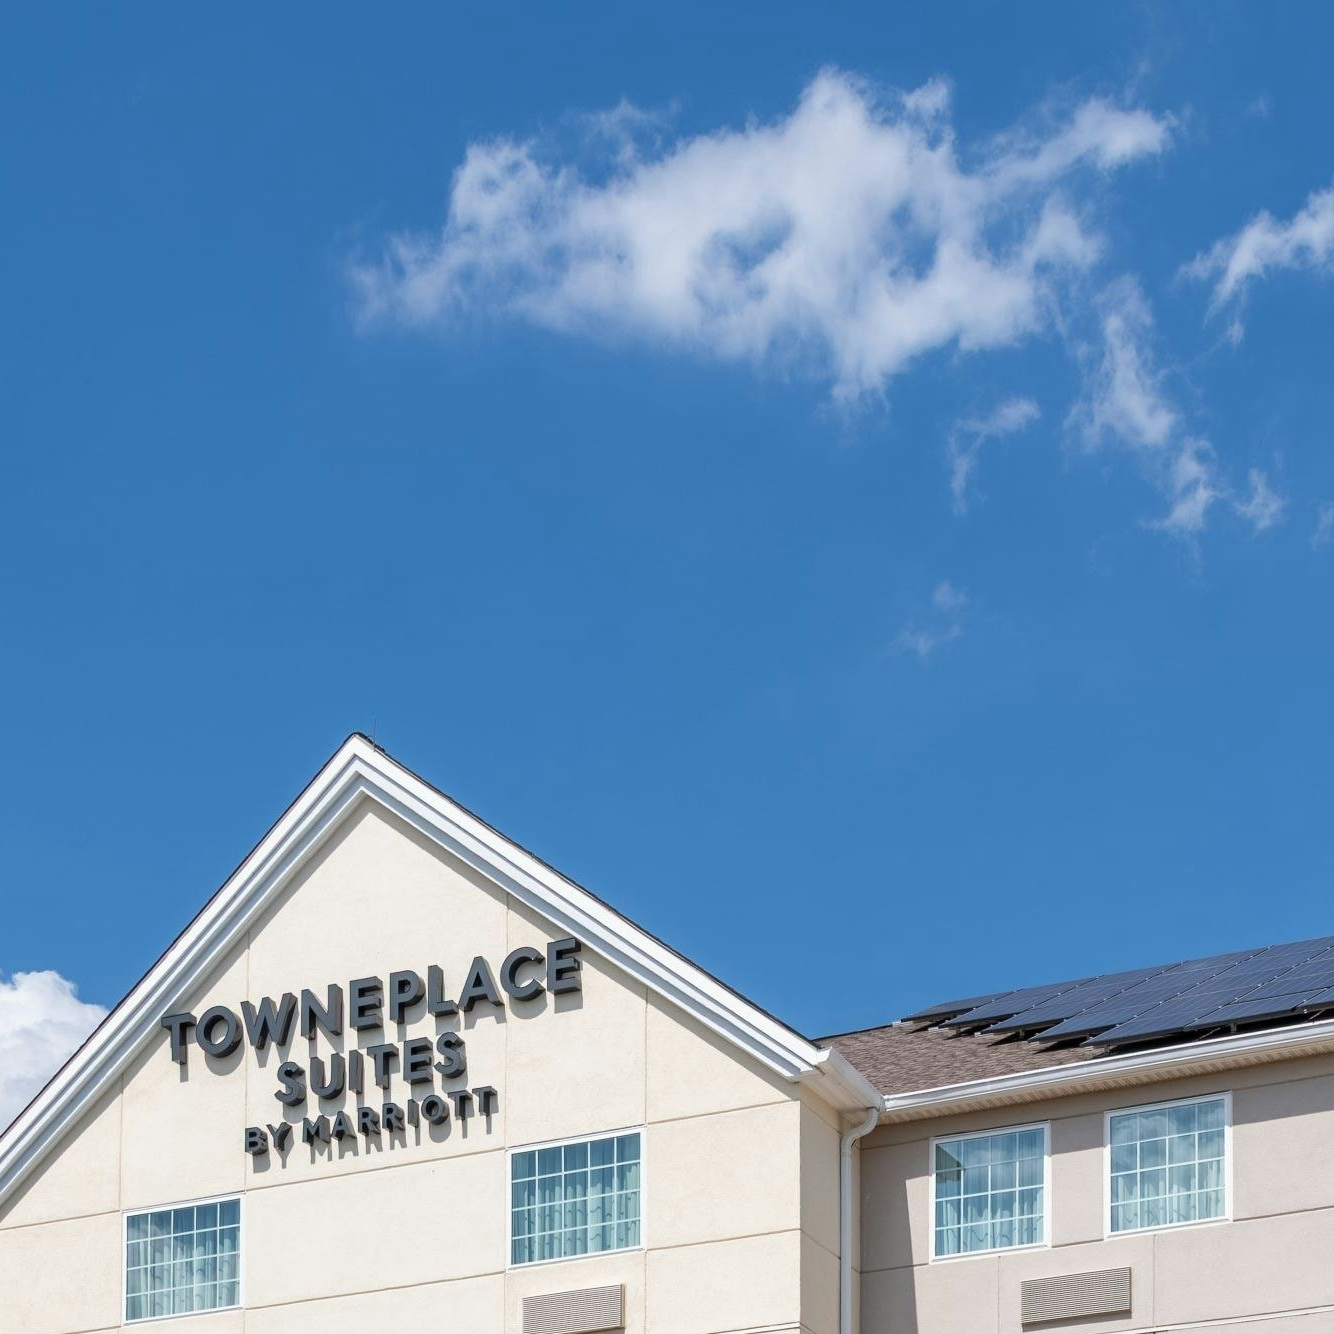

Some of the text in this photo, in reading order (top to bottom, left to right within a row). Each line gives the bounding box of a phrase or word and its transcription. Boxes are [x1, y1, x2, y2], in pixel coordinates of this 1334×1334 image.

[161, 938, 581, 1064] TOWNEPLACE
[274, 1031, 466, 1106] SUITES
[245, 1086, 498, 1156] BY MARRIOTT
